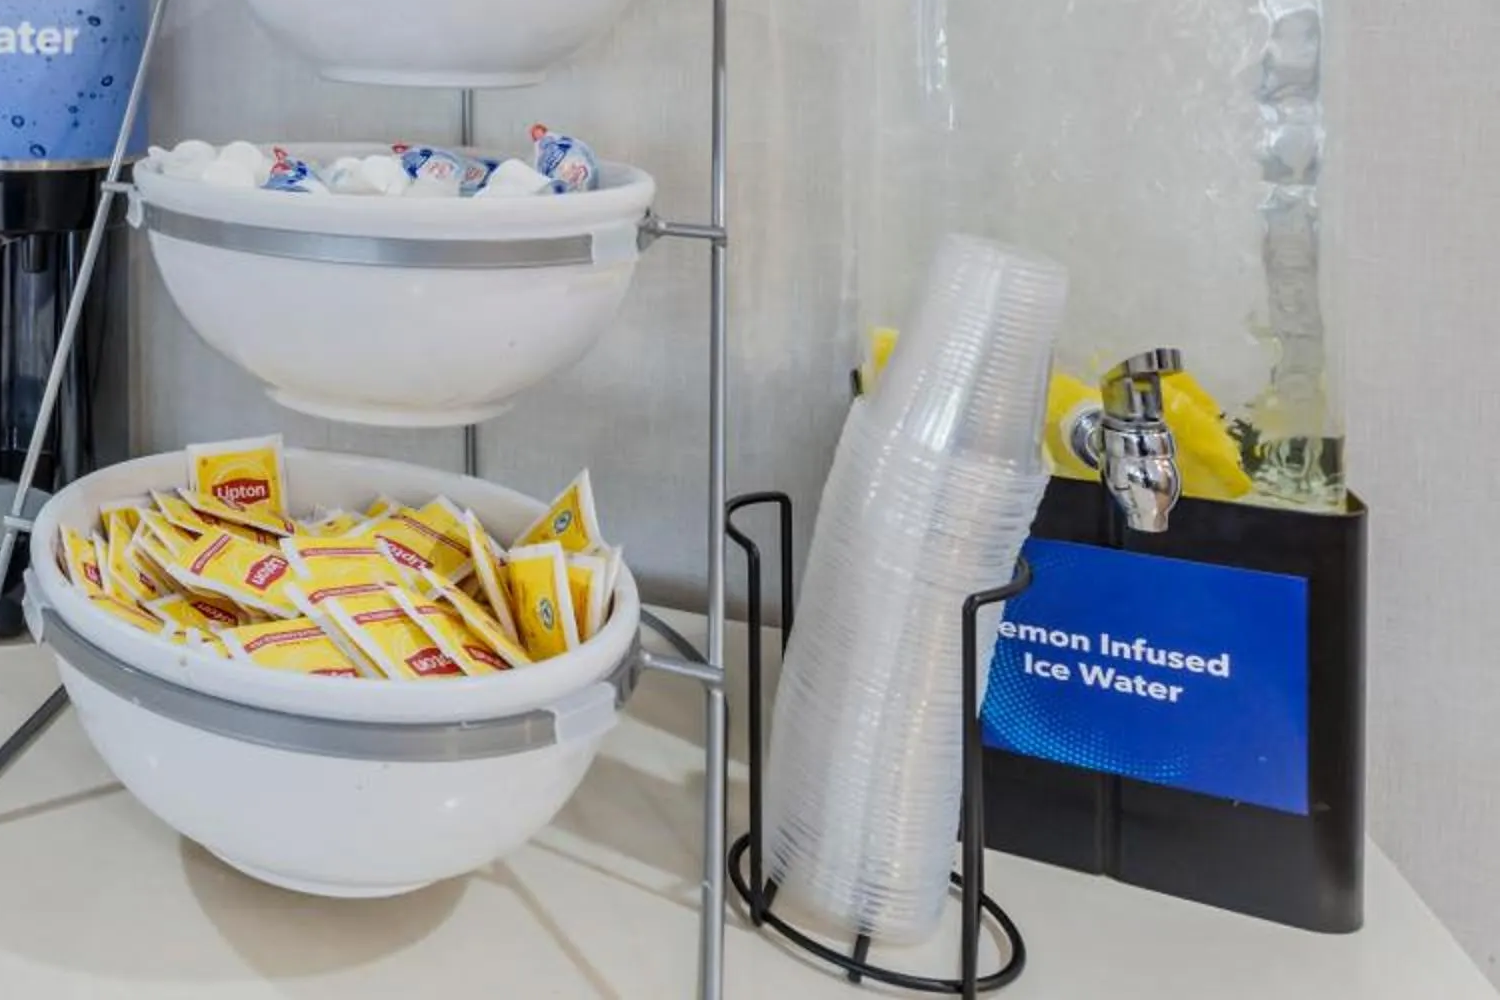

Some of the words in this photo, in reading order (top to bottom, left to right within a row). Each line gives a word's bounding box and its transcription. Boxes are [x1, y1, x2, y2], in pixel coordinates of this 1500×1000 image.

[216, 484, 266, 500] Lipton
[998, 620, 1090, 652] emon
[1100, 633, 1230, 678] Infused
[1024, 652, 1071, 681] Ice
[1078, 662, 1184, 703] Water
